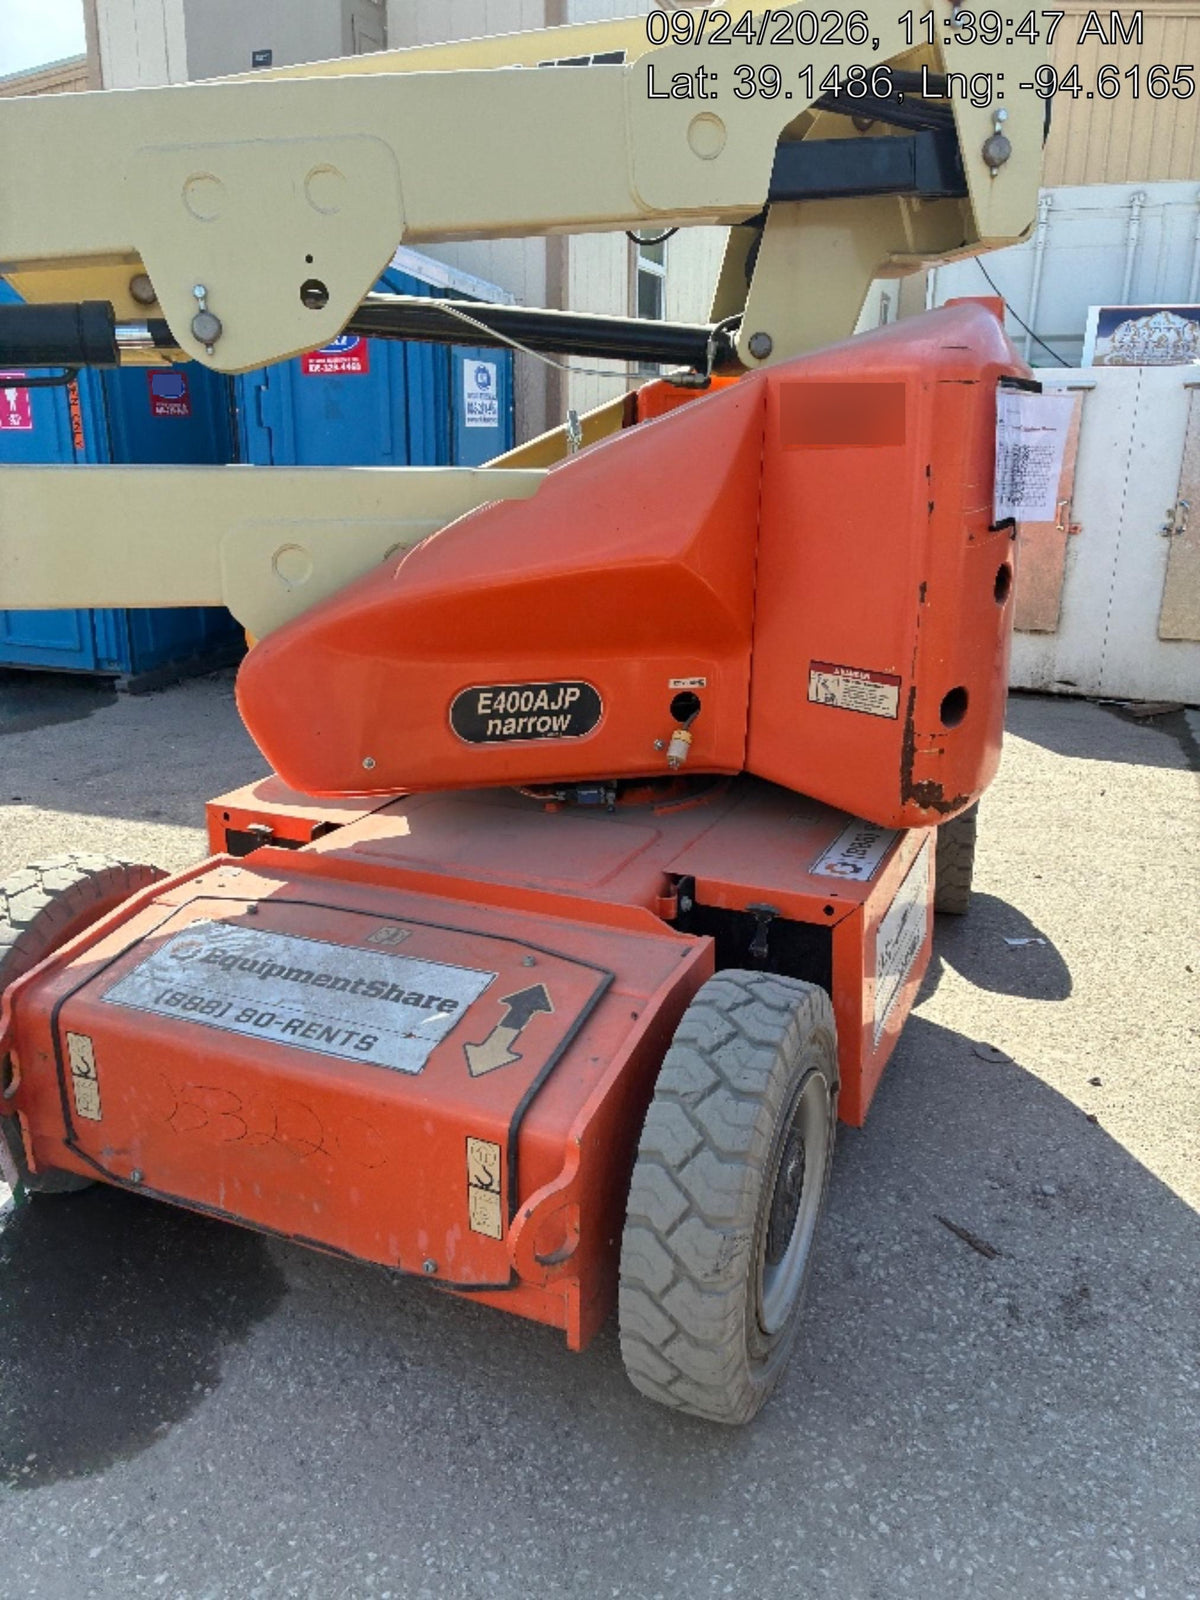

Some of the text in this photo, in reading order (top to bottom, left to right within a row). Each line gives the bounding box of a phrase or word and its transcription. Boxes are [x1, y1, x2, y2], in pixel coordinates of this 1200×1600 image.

[477, 687, 581, 715] E400AJP
[486, 713, 572, 736] narrow
[201, 947, 460, 1014] EquipmentShare
[155, 989, 234, 1018] (888)
